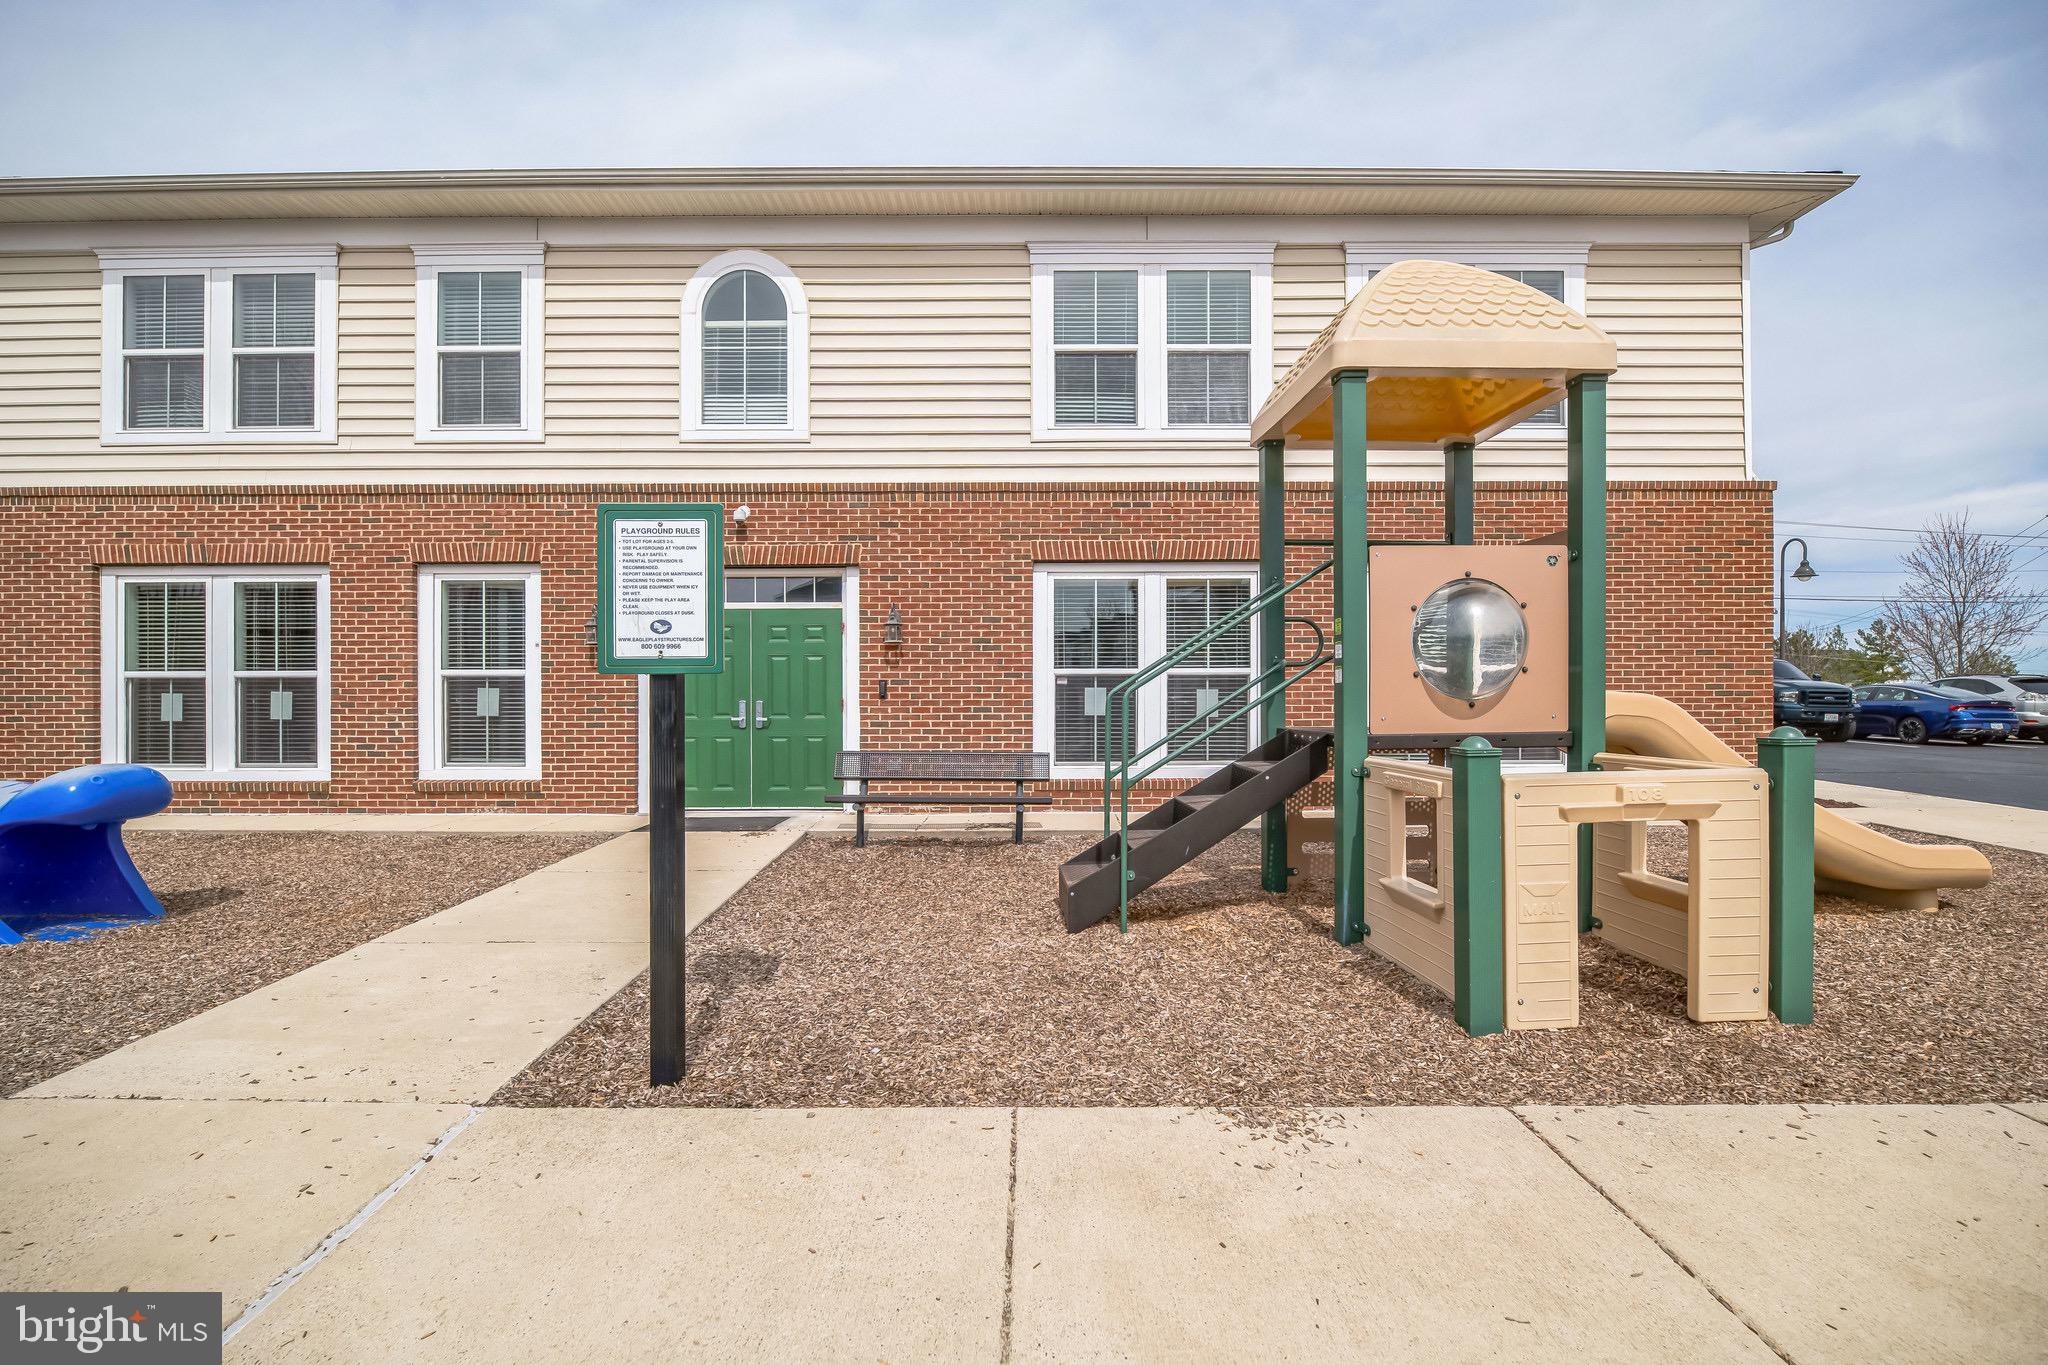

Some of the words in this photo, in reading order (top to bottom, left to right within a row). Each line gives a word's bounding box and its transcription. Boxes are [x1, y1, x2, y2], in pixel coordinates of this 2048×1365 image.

[621, 527, 674, 535] PLAYGROUND
[675, 527, 701, 535] RULES
[1523, 902, 1566, 917] MAIL
